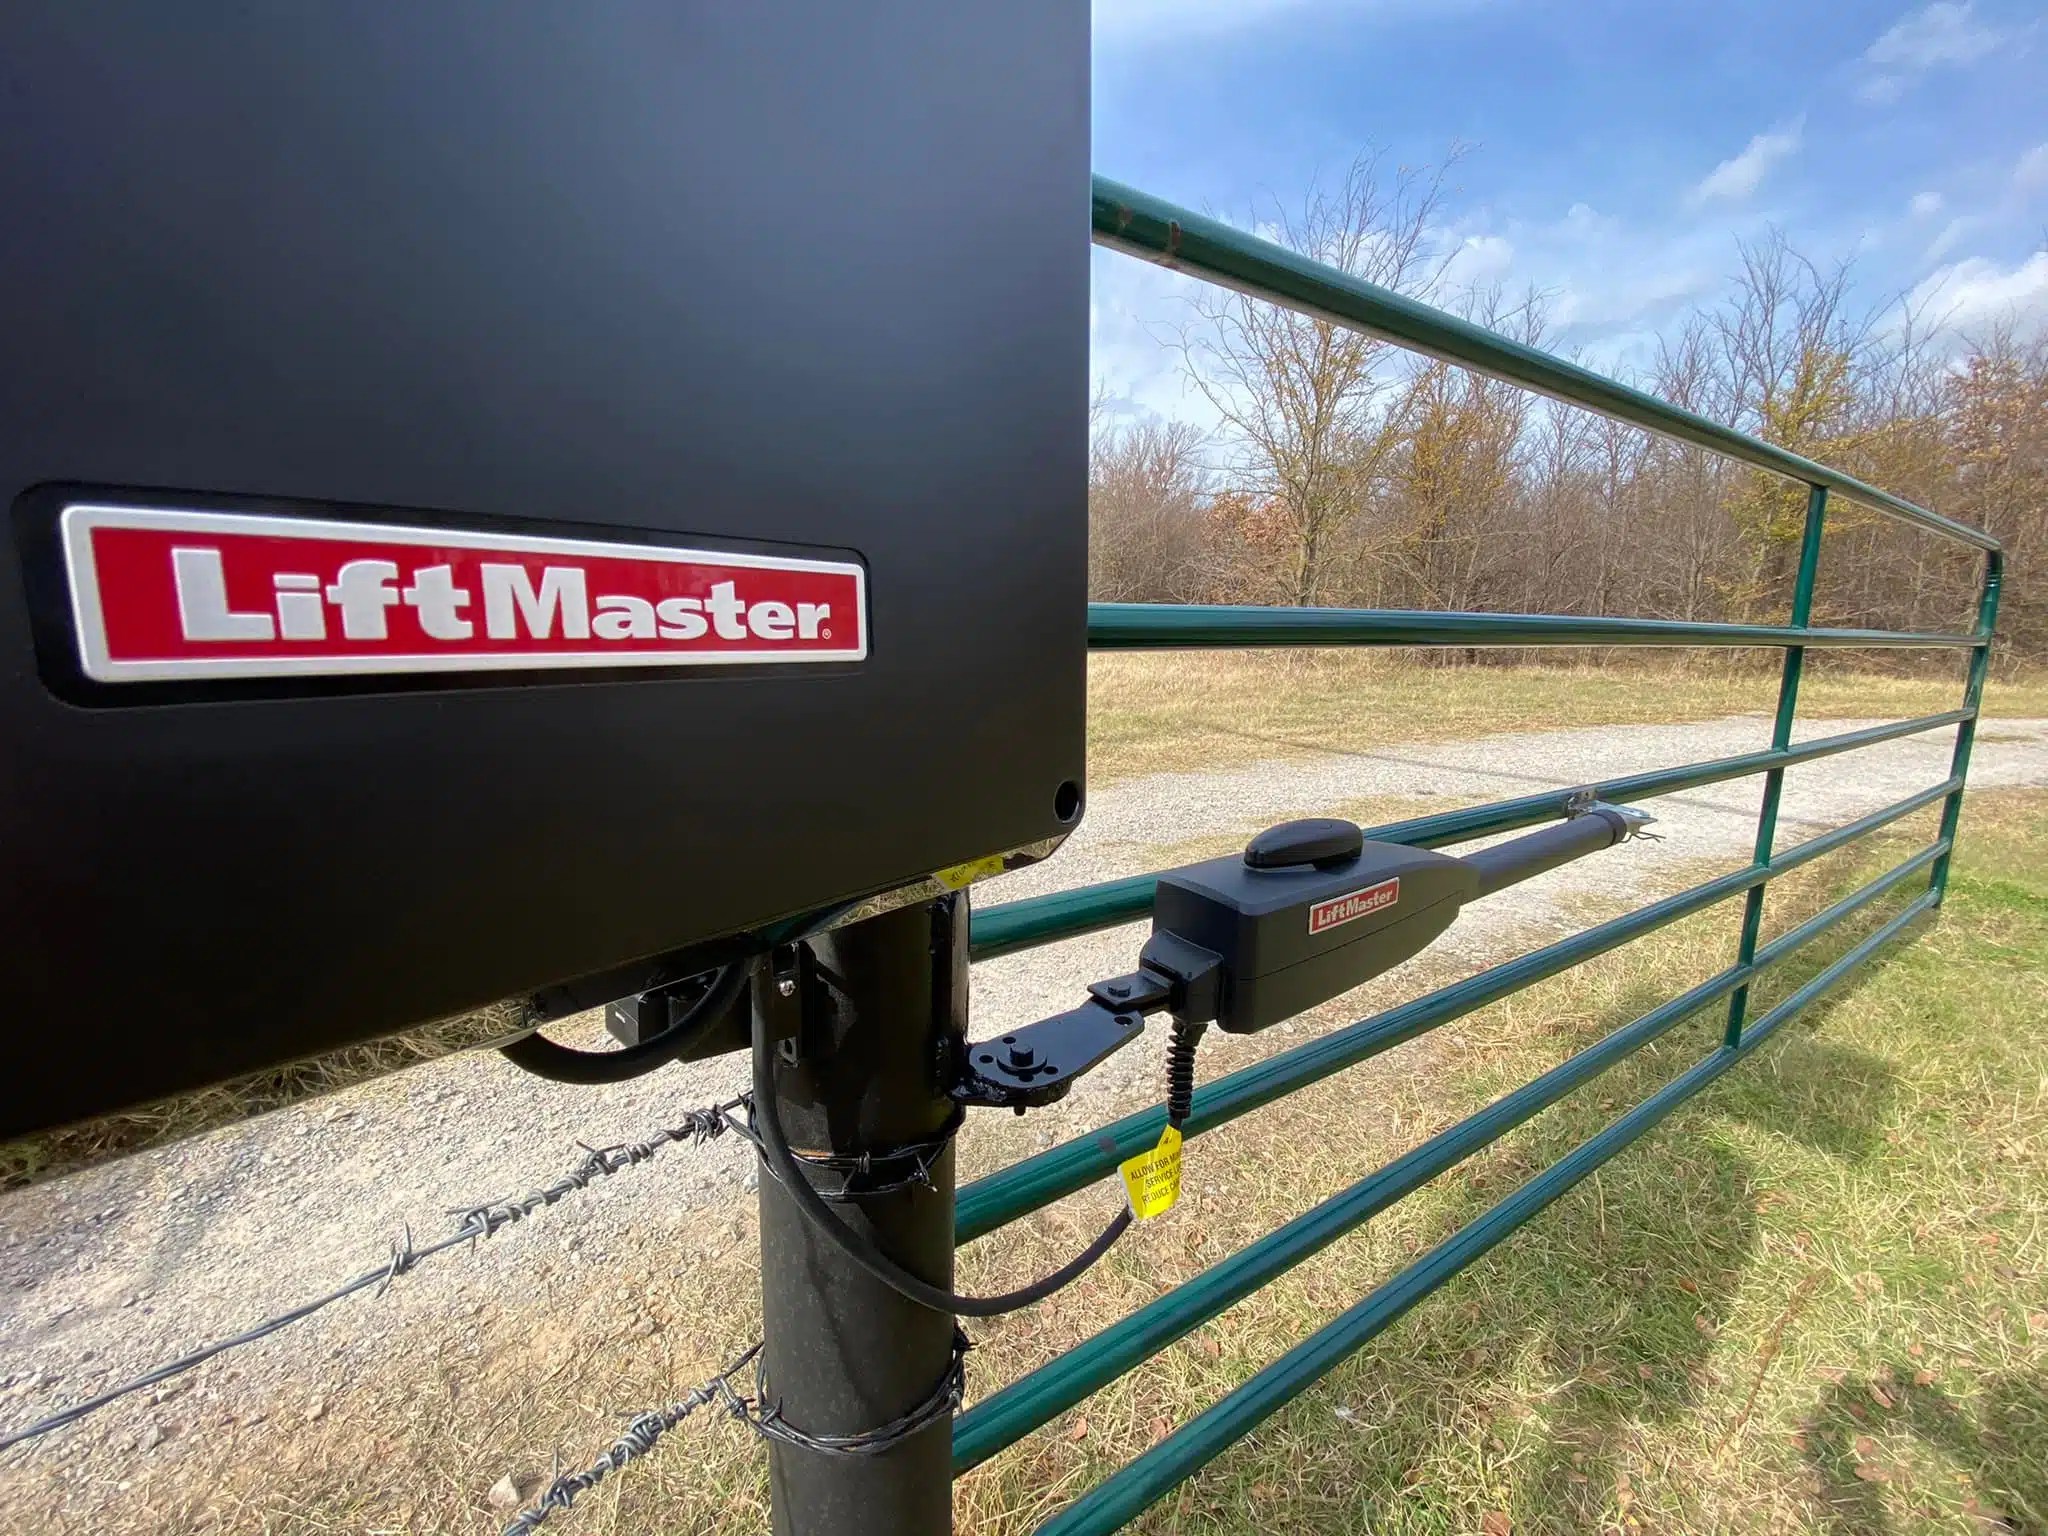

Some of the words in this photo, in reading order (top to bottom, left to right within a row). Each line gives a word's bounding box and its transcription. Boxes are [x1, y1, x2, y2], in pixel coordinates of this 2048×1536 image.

[171, 547, 830, 642] LiftMaster
[1318, 890, 1393, 926] LiftMaster
[1131, 1162, 1154, 1181] ALLOW
[1156, 1156, 1170, 1171] FOR
[1145, 1168, 1173, 1189] SERVICE
[1141, 1185, 1169, 1207] REDUCE
